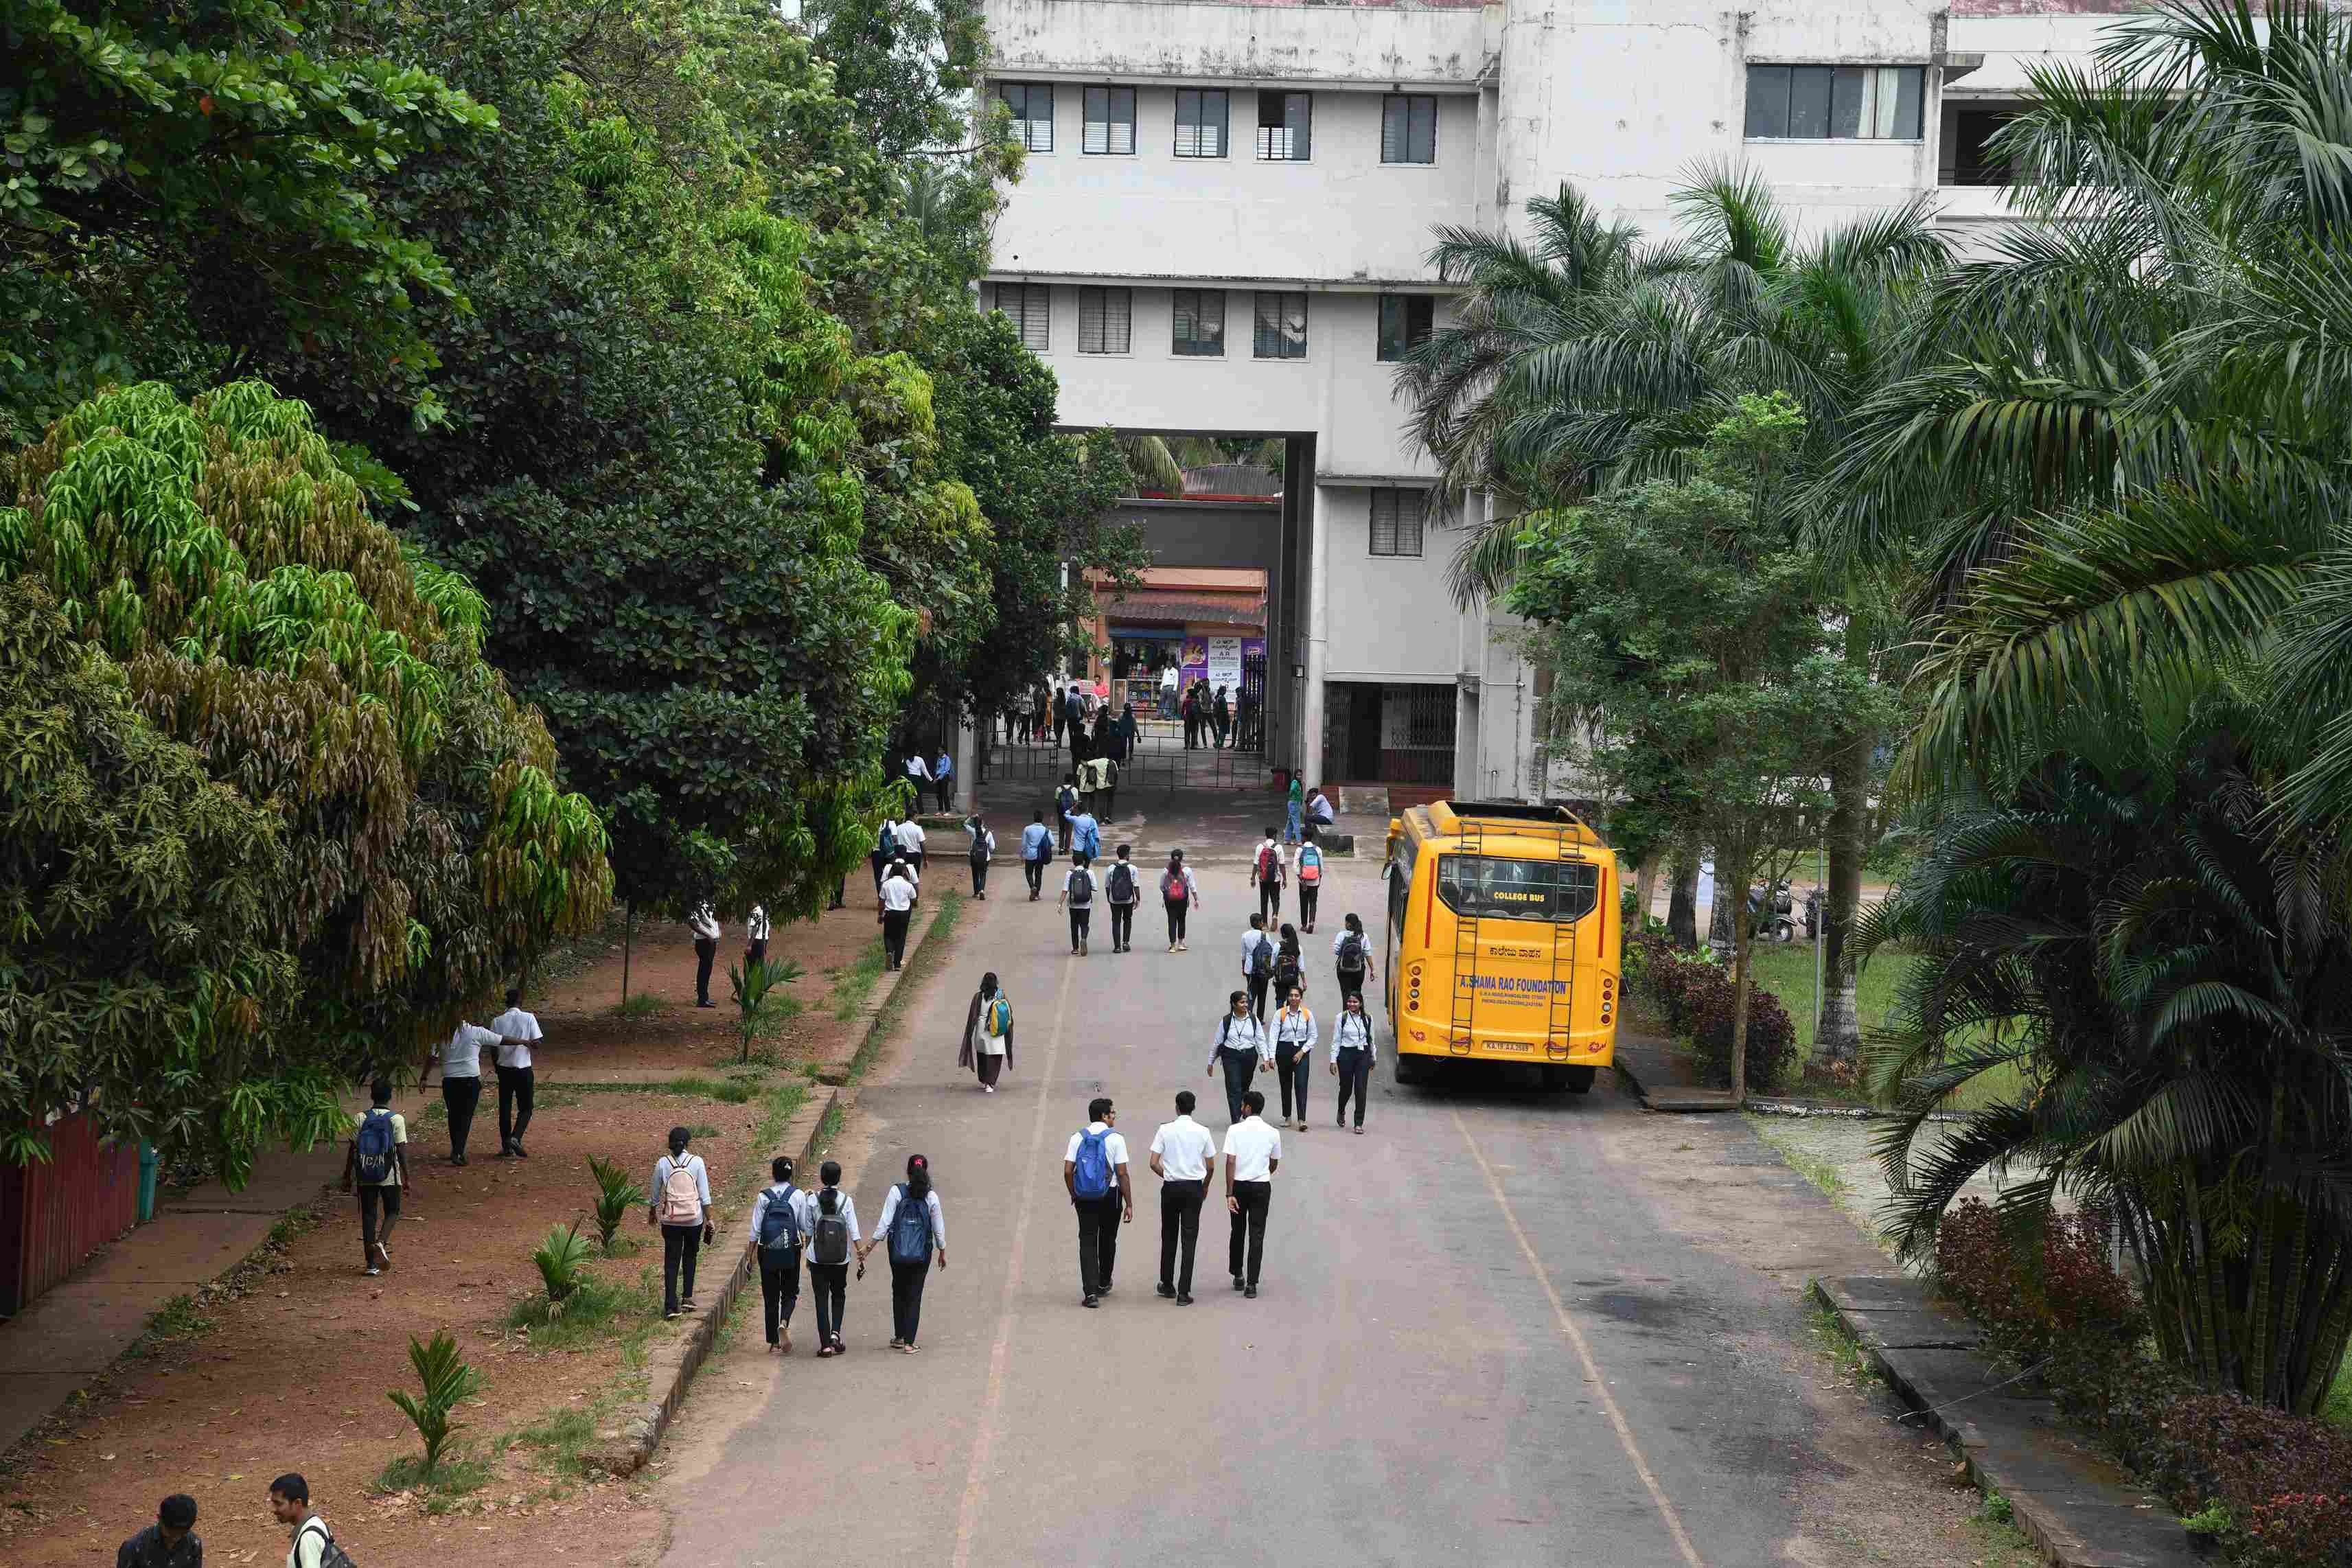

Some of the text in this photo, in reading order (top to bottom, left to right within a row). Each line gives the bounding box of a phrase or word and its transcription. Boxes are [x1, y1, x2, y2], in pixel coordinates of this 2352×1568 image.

[1494, 891, 1545, 902] COLLEGE BUS
[1499, 977, 1514, 991] RAO
[1517, 978, 1566, 995] FOUNDATION
